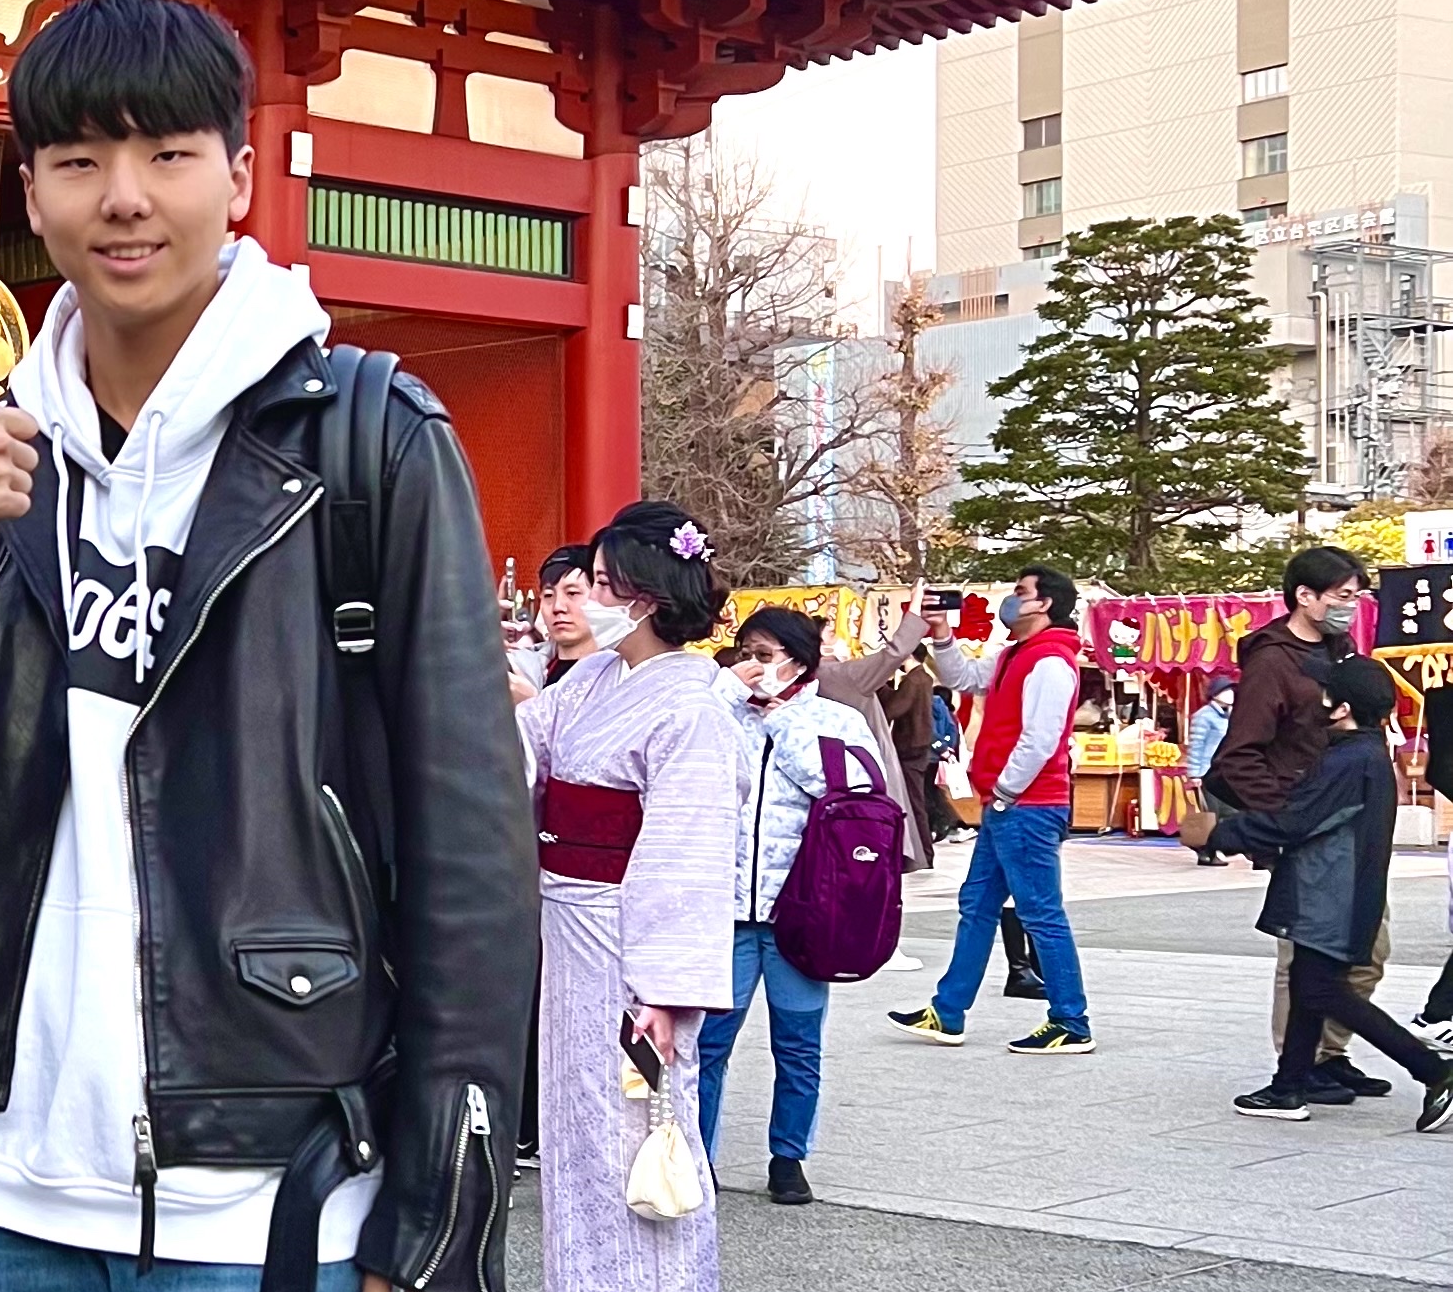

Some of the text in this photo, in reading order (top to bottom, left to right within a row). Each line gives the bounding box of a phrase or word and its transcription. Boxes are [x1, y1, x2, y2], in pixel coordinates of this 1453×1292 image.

[1253, 206, 1396, 246] 区立台東区民会館
